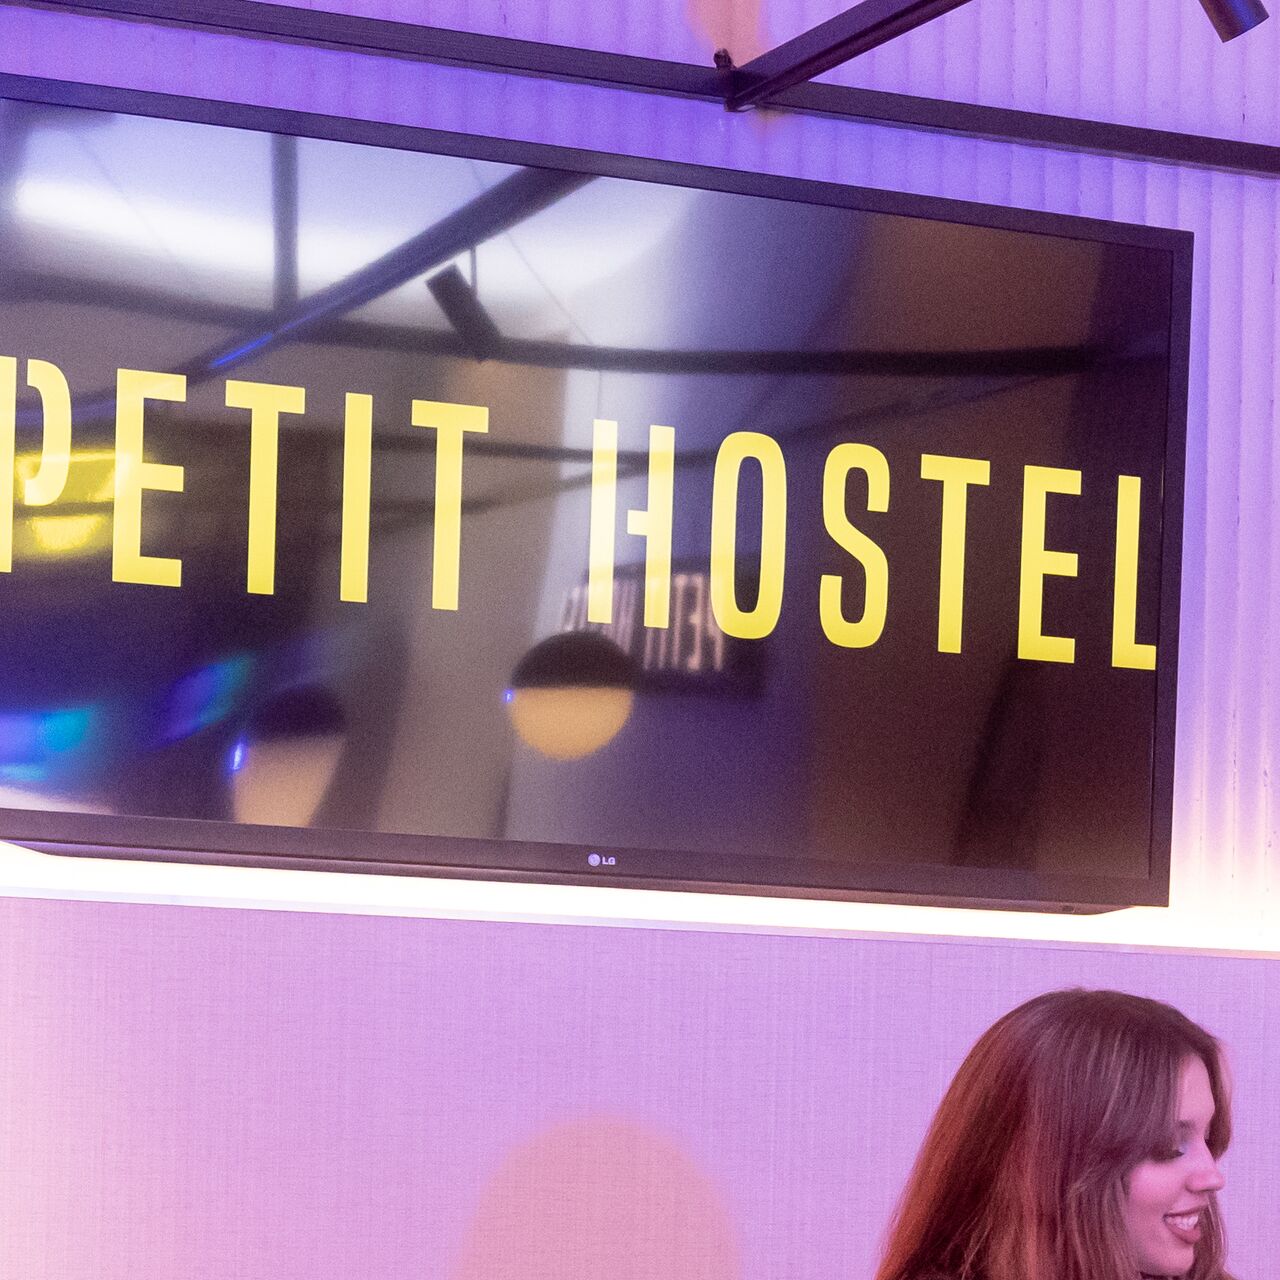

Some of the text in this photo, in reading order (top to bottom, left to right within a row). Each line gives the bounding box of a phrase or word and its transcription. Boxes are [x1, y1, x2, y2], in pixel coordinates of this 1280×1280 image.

[0, 355, 1157, 671] PETIT HOSTEL
[602, 856, 616, 866] LG
